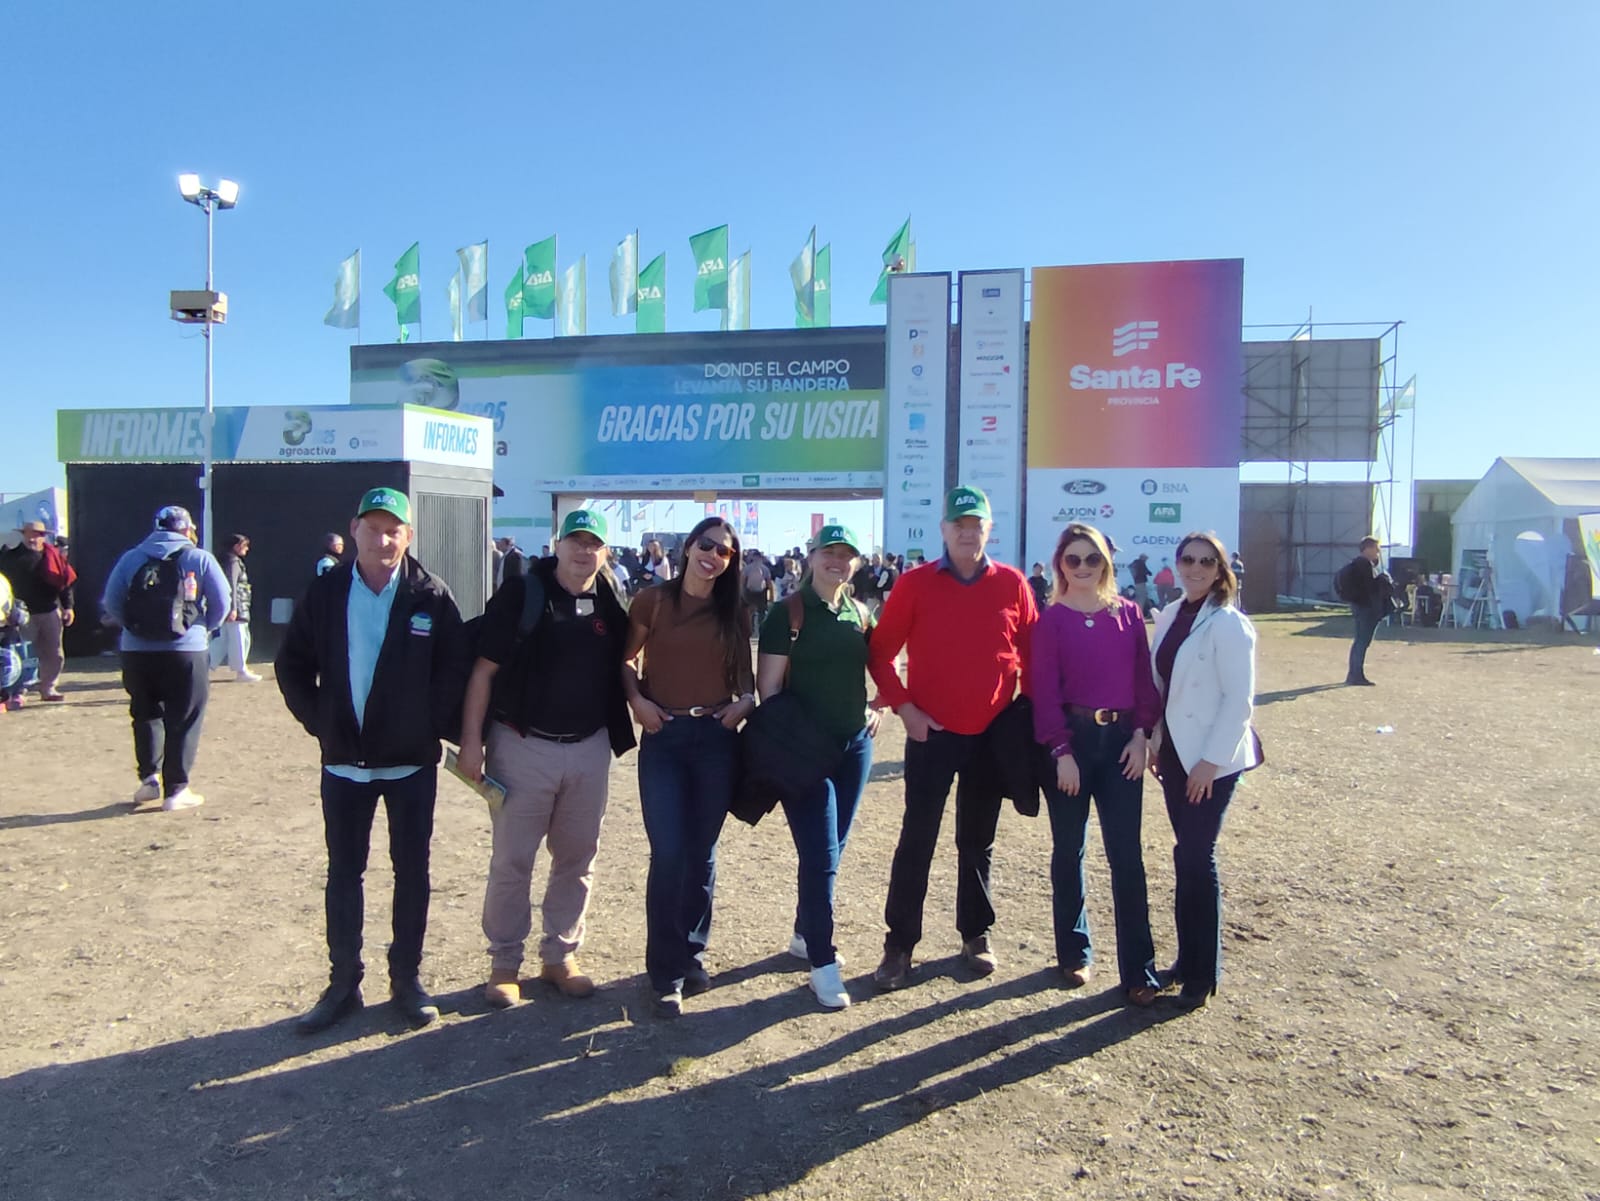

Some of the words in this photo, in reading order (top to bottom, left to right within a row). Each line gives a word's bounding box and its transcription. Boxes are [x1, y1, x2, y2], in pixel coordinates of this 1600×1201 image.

[704, 362, 763, 378] DONDE
[767, 361, 784, 376] EL
[788, 359, 850, 375] CAMPO
[1069, 364, 1161, 390] Santa
[1166, 362, 1202, 389] Fe
[675, 379, 743, 394] LEVANTA
[746, 379, 768, 393] SU
[772, 376, 850, 392] BANDERA
[597, 403, 702, 442] GRACIAS
[704, 402, 755, 440] POR
[760, 400, 799, 440] SU
[801, 400, 880, 438] VISITA
[423, 421, 479, 456] INFORMES
[279, 447, 337, 457] agroactiva
[1068, 480, 1100, 494] Ford
[1162, 483, 1188, 493] BNA
[955, 496, 976, 506] AFA
[1058, 507, 1096, 516] AXION
[1154, 506, 1176, 516] AFA
[1132, 535, 1182, 545] CADENA
